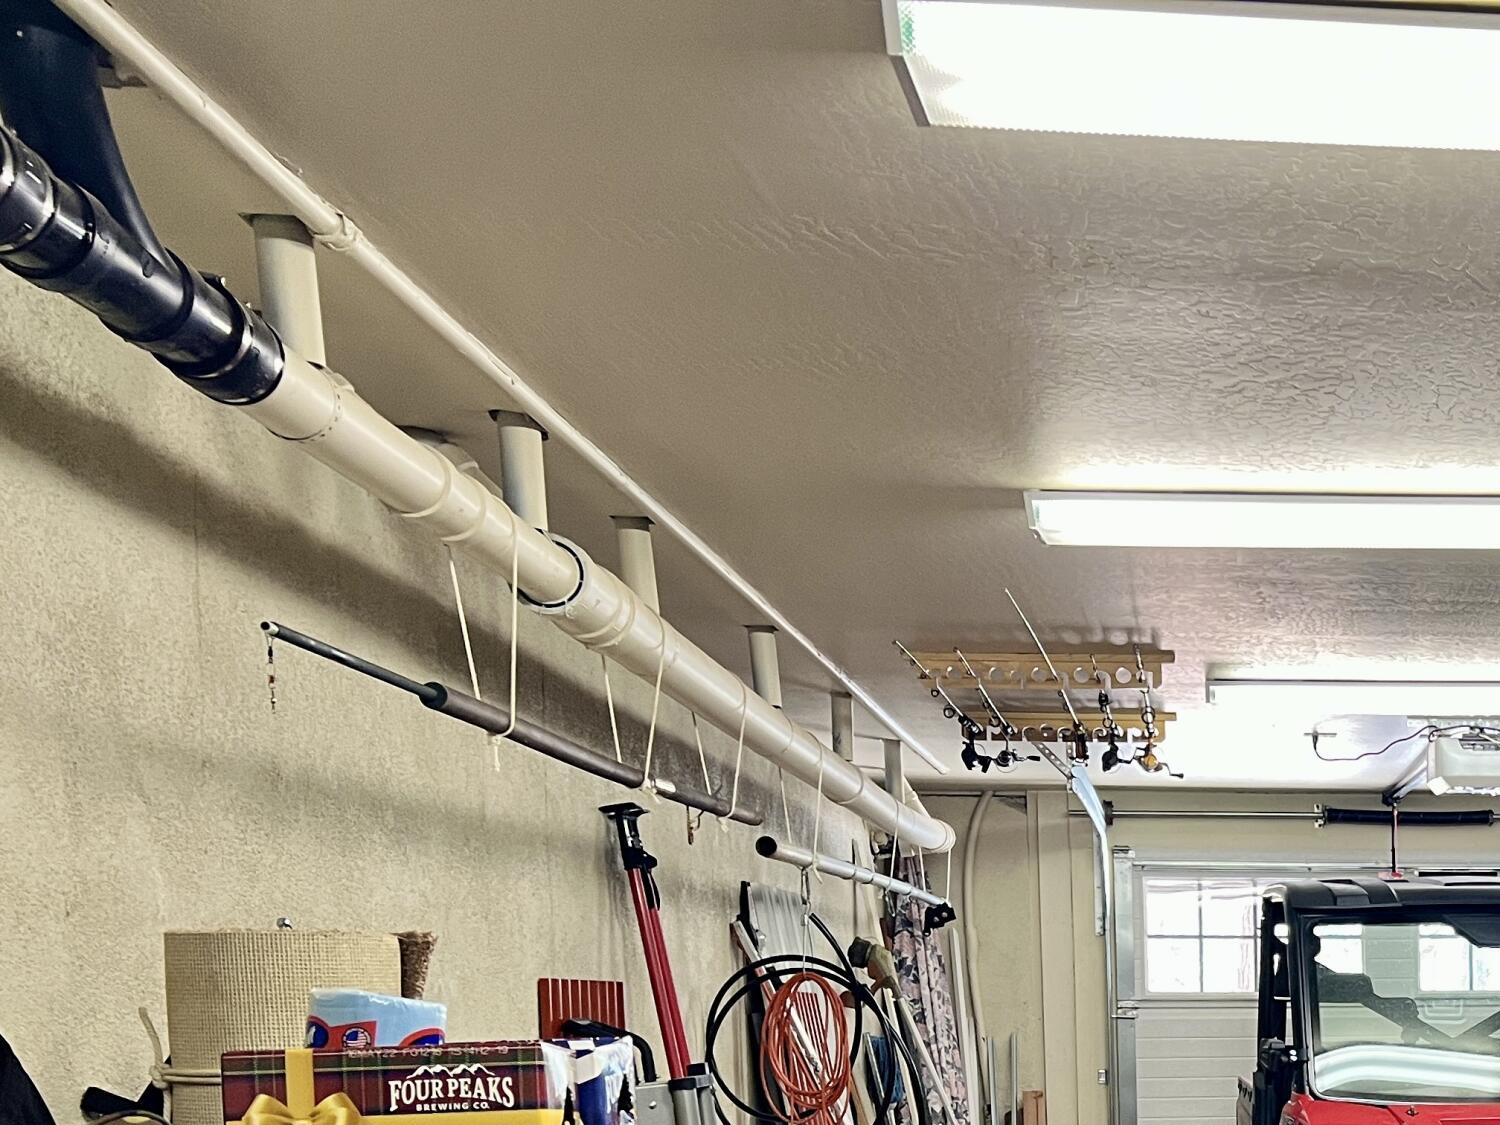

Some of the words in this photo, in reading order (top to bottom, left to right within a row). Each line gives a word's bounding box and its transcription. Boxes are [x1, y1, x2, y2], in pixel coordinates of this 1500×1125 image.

[388, 1077, 442, 1112] FOUR
[448, 1076, 515, 1108] PEAKS
[416, 1102, 469, 1112] BREWING
